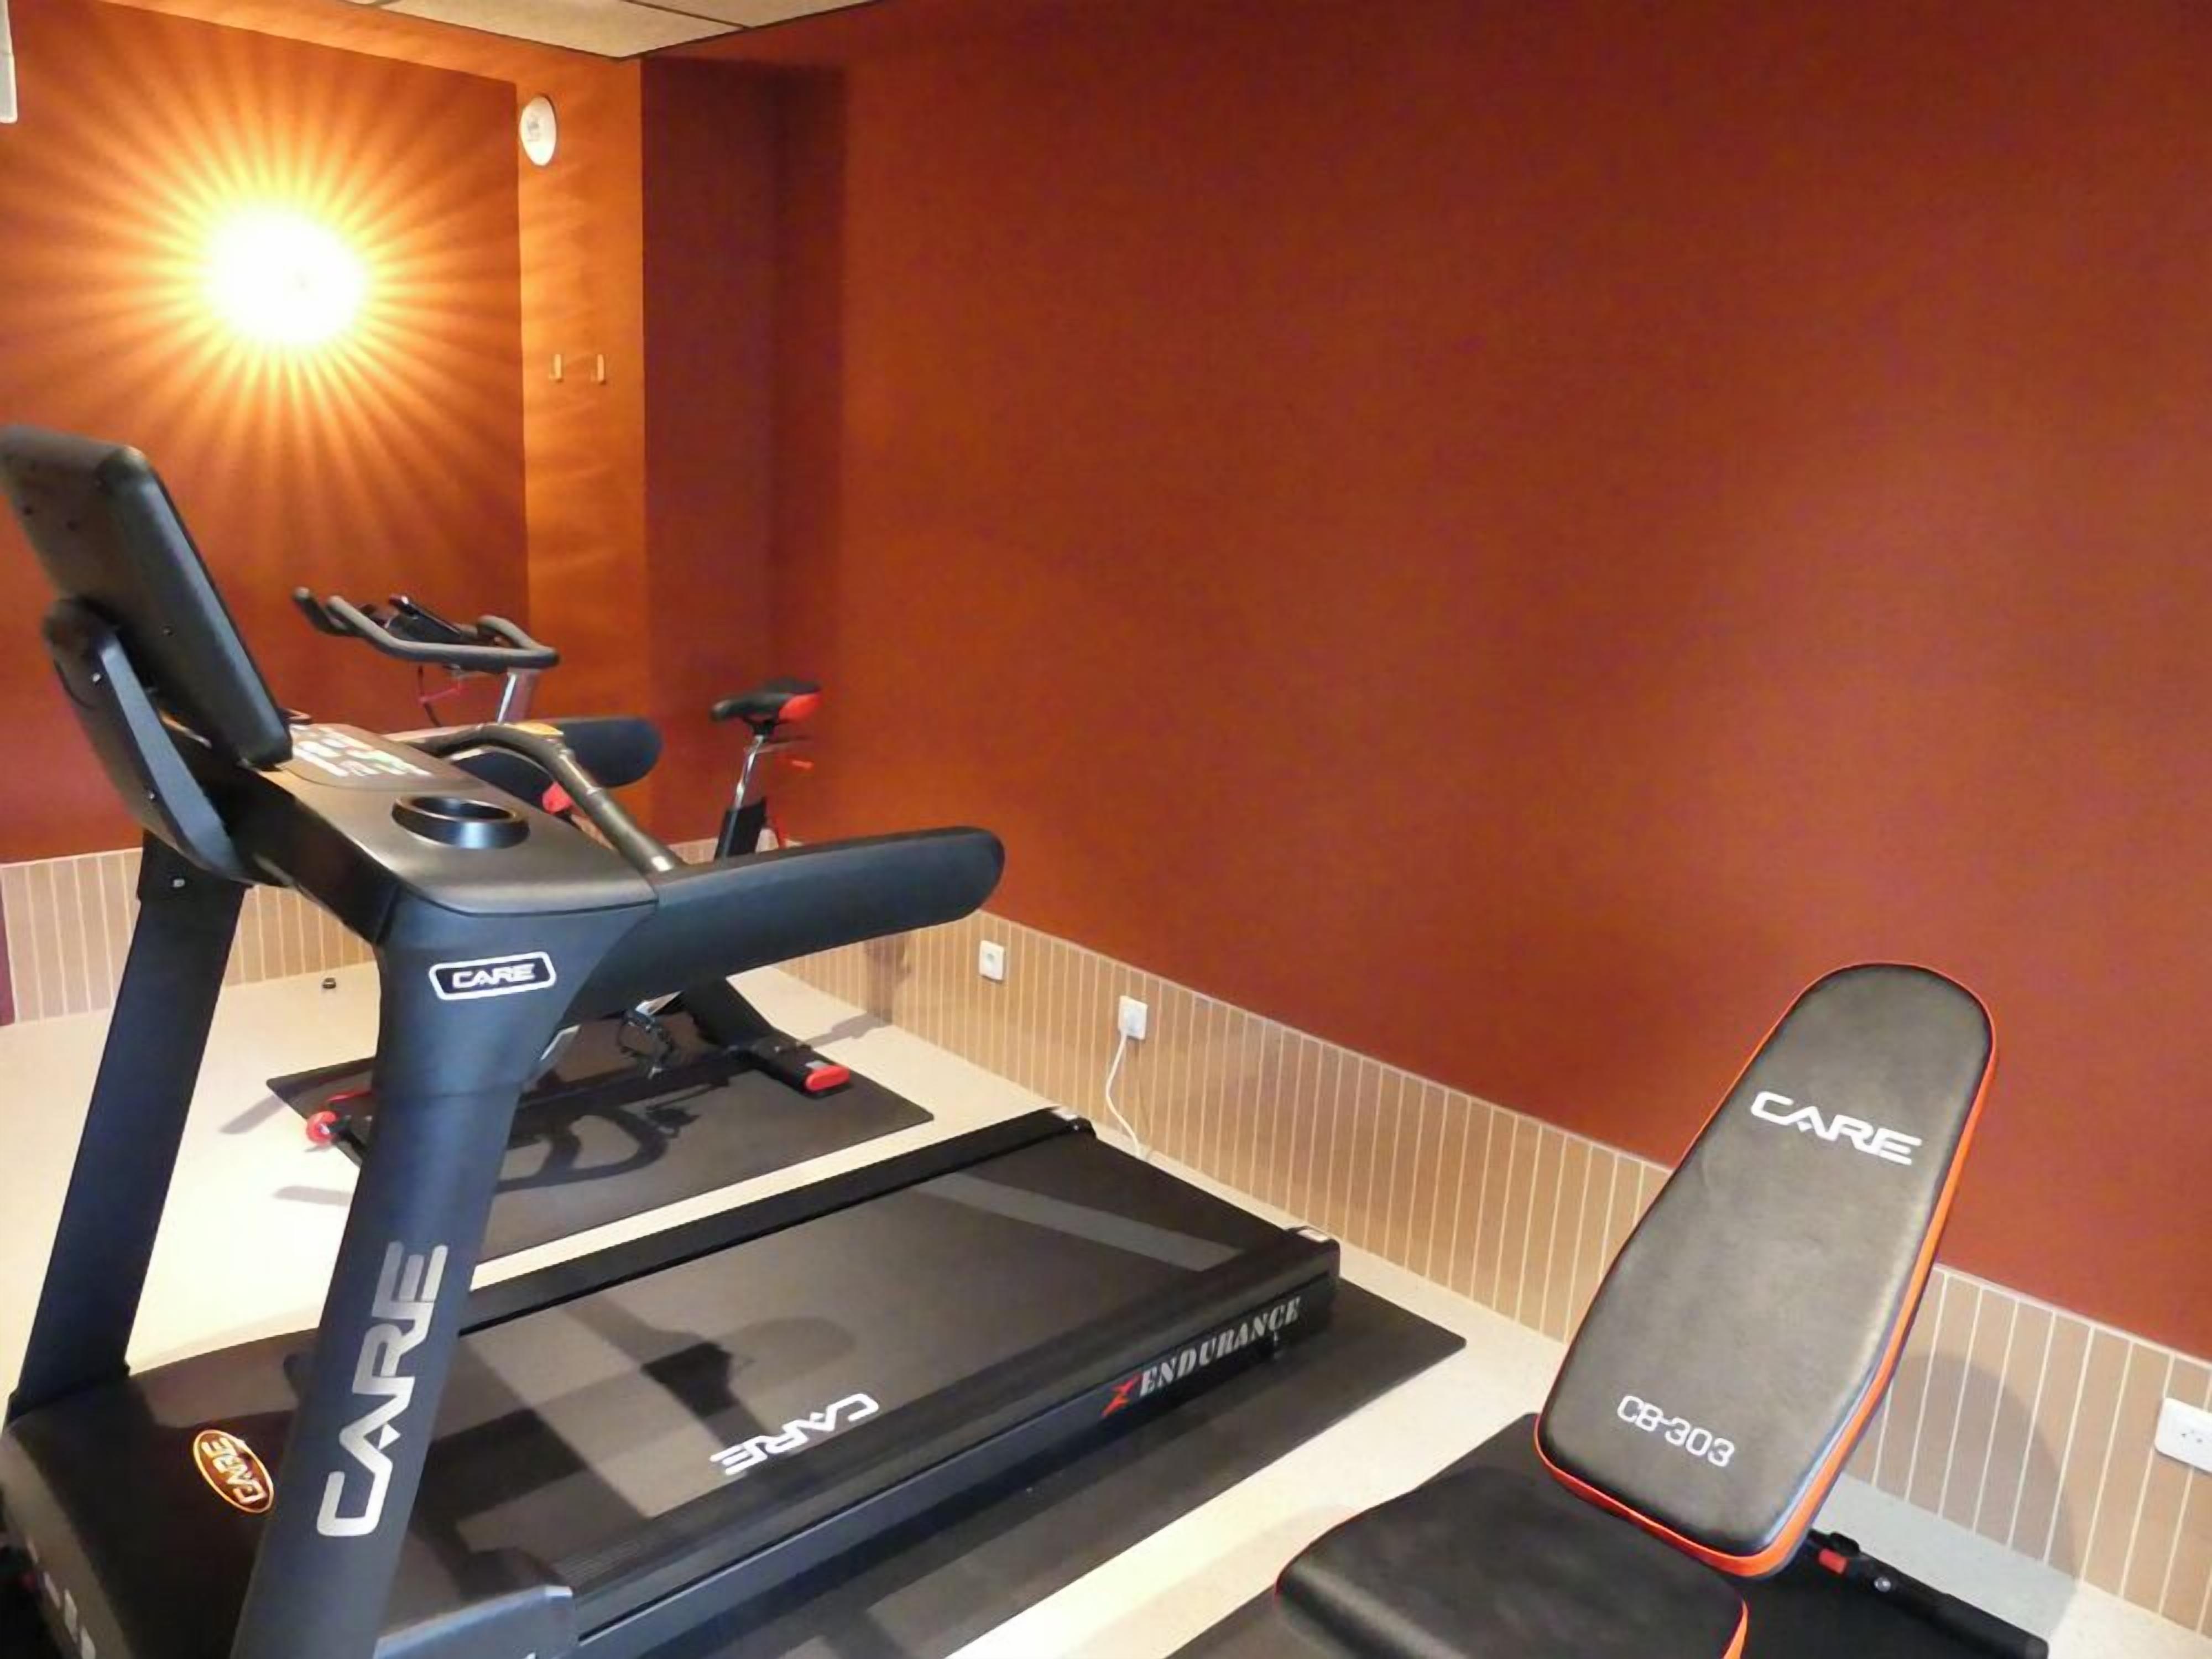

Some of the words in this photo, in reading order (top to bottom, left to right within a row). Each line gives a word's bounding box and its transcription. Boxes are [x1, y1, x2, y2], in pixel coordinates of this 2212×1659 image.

[452, 963, 535, 989] CARE
[1750, 1091, 1923, 1166] CARE
[316, 1240, 448, 1538] CARE
[709, 1392, 880, 1476] CARE
[1617, 1395, 1735, 1467] CB-303
[200, 1437, 268, 1505] CARE
